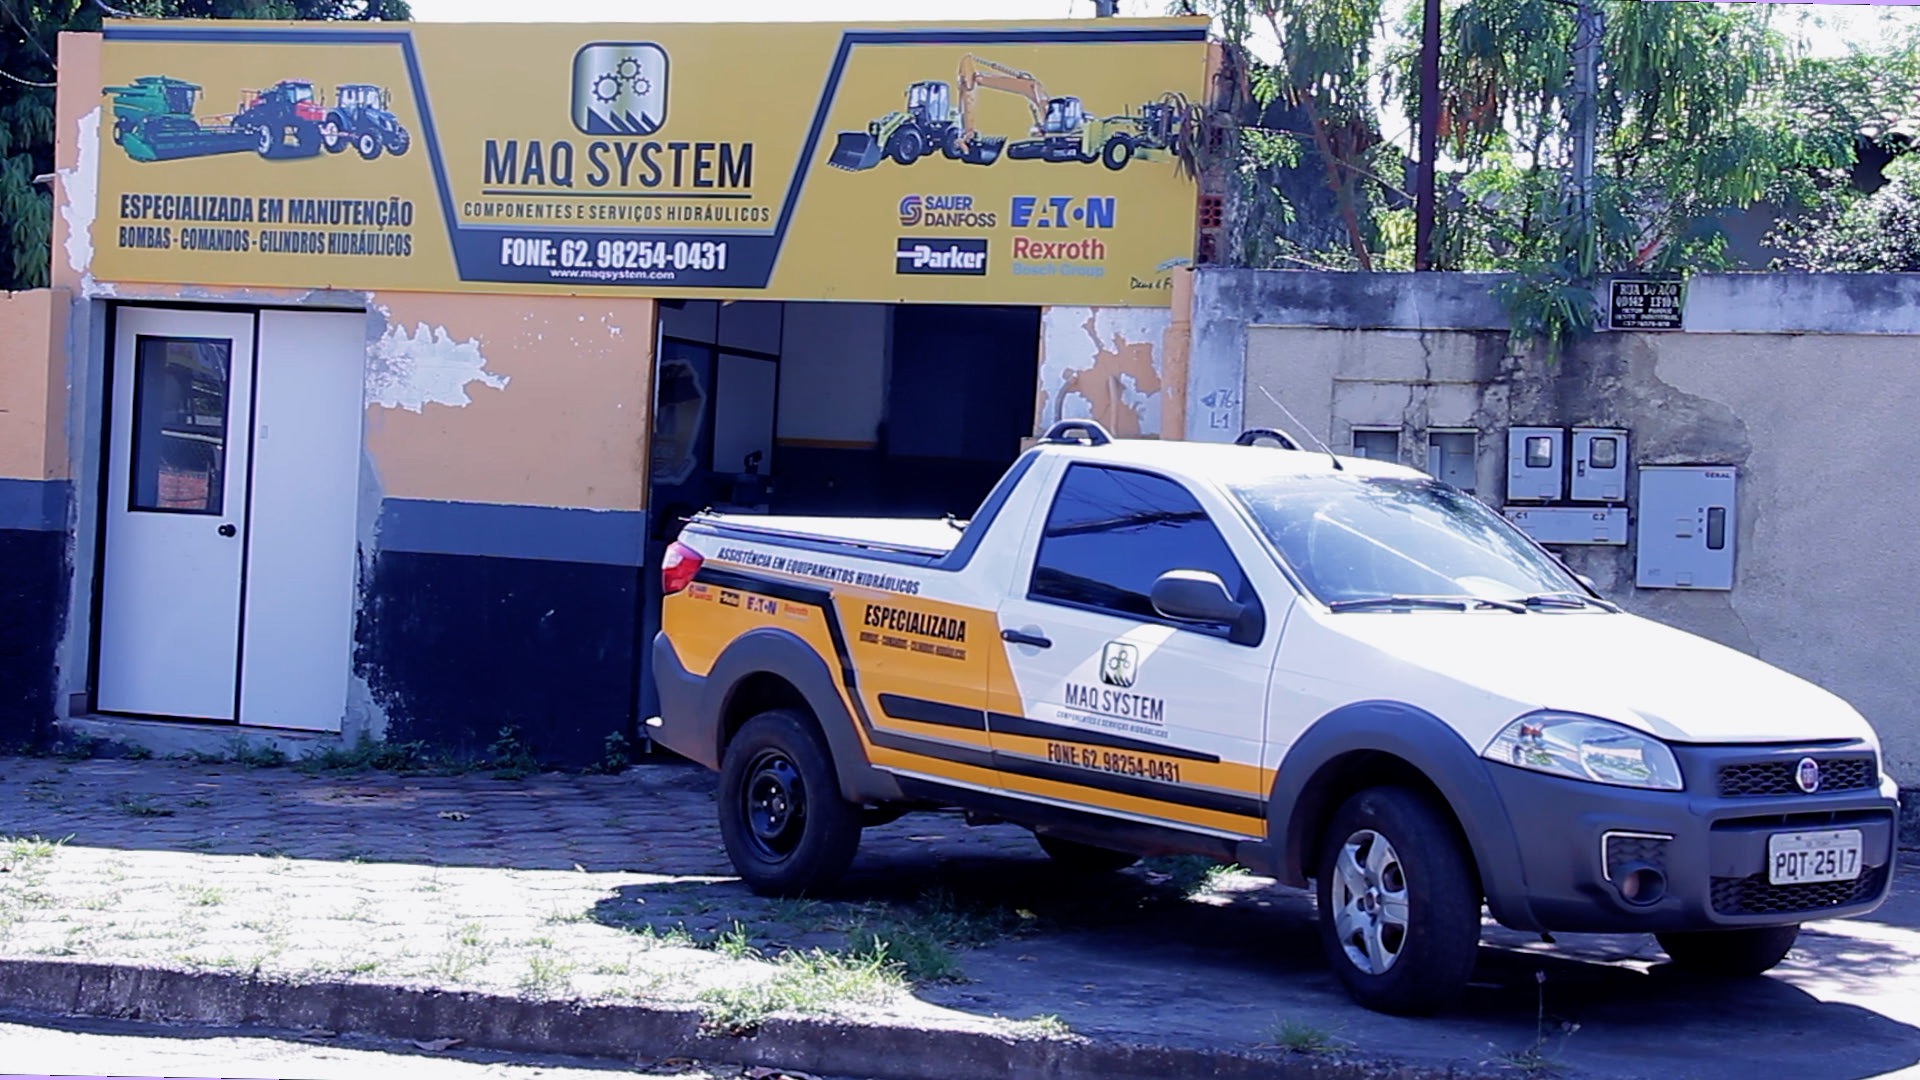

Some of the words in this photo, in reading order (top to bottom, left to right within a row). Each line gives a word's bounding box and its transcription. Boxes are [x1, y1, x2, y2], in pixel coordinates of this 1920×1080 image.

[484, 140, 573, 188] MAQ
[586, 141, 753, 188] SYSTEM
[120, 194, 253, 222] ESPECIALIZADA
[258, 198, 284, 223] EM
[288, 196, 413, 231] MANUTENÇÃO
[464, 202, 572, 219] COMPONENTES
[577, 205, 585, 219] E
[589, 205, 662, 222] SERVIÇOS
[667, 204, 770, 221] HIDRÁULICOS
[925, 195, 973, 210] SAUER
[924, 212, 997, 227] DANFOSS
[119, 226, 171, 249] BOMBAS
[181, 228, 249, 251] COMANDOS
[260, 230, 325, 254] CILINDROS
[328, 229, 412, 256] HIDRÁULICOS
[501, 238, 557, 267] FONE:
[597, 240, 727, 270] 98254-0431
[913, 245, 985, 268] Parker
[1013, 237, 1105, 260] Rexroth
[550, 269, 675, 280] www.maqsystem.com
[717, 547, 770, 569] ASSISTÊNCIA
[772, 556, 785, 570] EM
[786, 558, 854, 583] EQUIPAMENTOS
[855, 572, 921, 595] HIDRÁULICOS
[864, 604, 966, 642] ESPECIALIZADA
[1065, 683, 1099, 710] MAQ
[1101, 690, 1164, 721] SYSTEM
[1047, 743, 1080, 765] FONE:
[1103, 752, 1181, 783] 98254-0431
